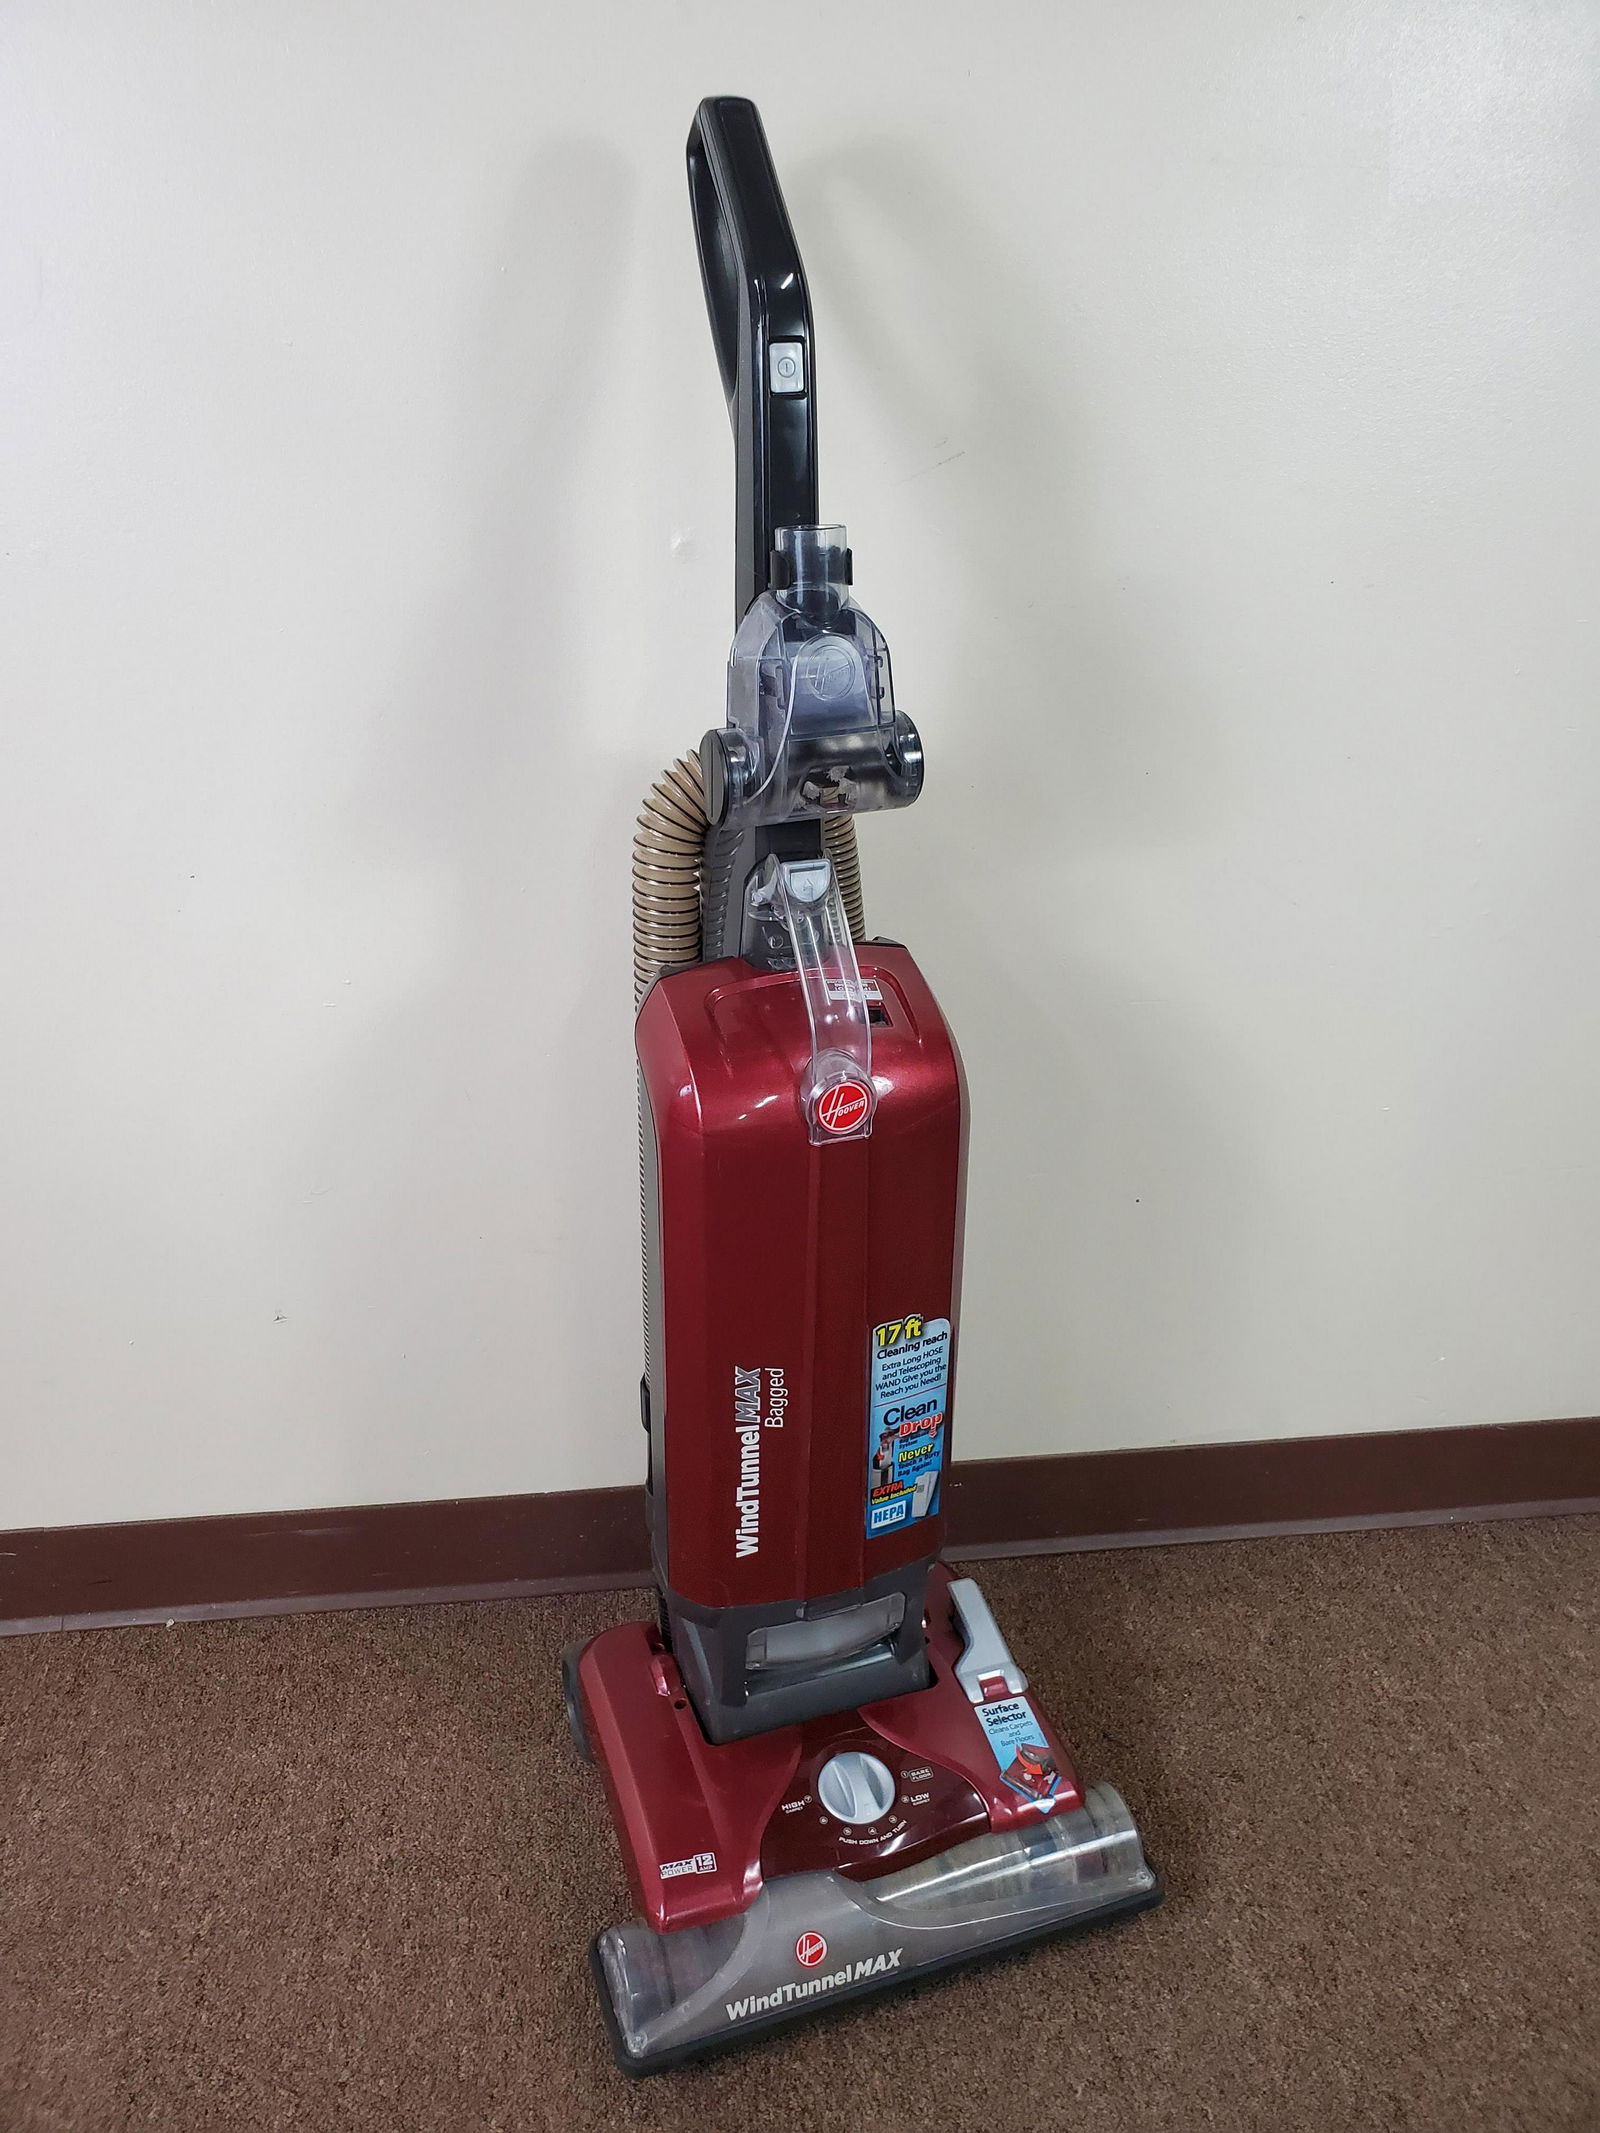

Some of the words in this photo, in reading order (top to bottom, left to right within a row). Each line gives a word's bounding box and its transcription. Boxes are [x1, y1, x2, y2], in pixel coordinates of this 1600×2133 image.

[877, 1341, 920, 1360] Cleaning
[922, 1331, 948, 1347] reach
[881, 1361, 902, 1372] Extra
[902, 1354, 922, 1367] Long
[922, 1346, 944, 1359] HOSE
[875, 1378, 901, 1391] WAND
[902, 1372, 919, 1383] Give
[919, 1368, 934, 1380] you
[934, 1363, 947, 1373] the
[882, 1370, 898, 1381] and
[898, 1357, 942, 1375] Telescoping
[764, 1367, 788, 1428] Bagged
[880, 1385, 904, 1399] Reach
[904, 1382, 919, 1393] you
[883, 1399, 938, 1426] Clean
[899, 1412, 943, 1437] Drop
[898, 1443, 934, 1463] Never
[872, 1481, 904, 1498] EXTRA
[874, 1504, 904, 1523] HEPA
[981, 1702, 1020, 1717] Surface
[986, 1711, 1027, 1727] Selector
[988, 1725, 1010, 1735] Cleans
[1009, 1720, 1034, 1732] Carpets
[781, 1800, 806, 1811] HIGH
[910, 1792, 930, 1802] LOW
[838, 1836, 858, 1845] PUSH
[879, 1831, 894, 1842] AND
[662, 1860, 693, 1871] MAX
[695, 1854, 714, 1867] 12
[661, 1865, 694, 1877] POWER
